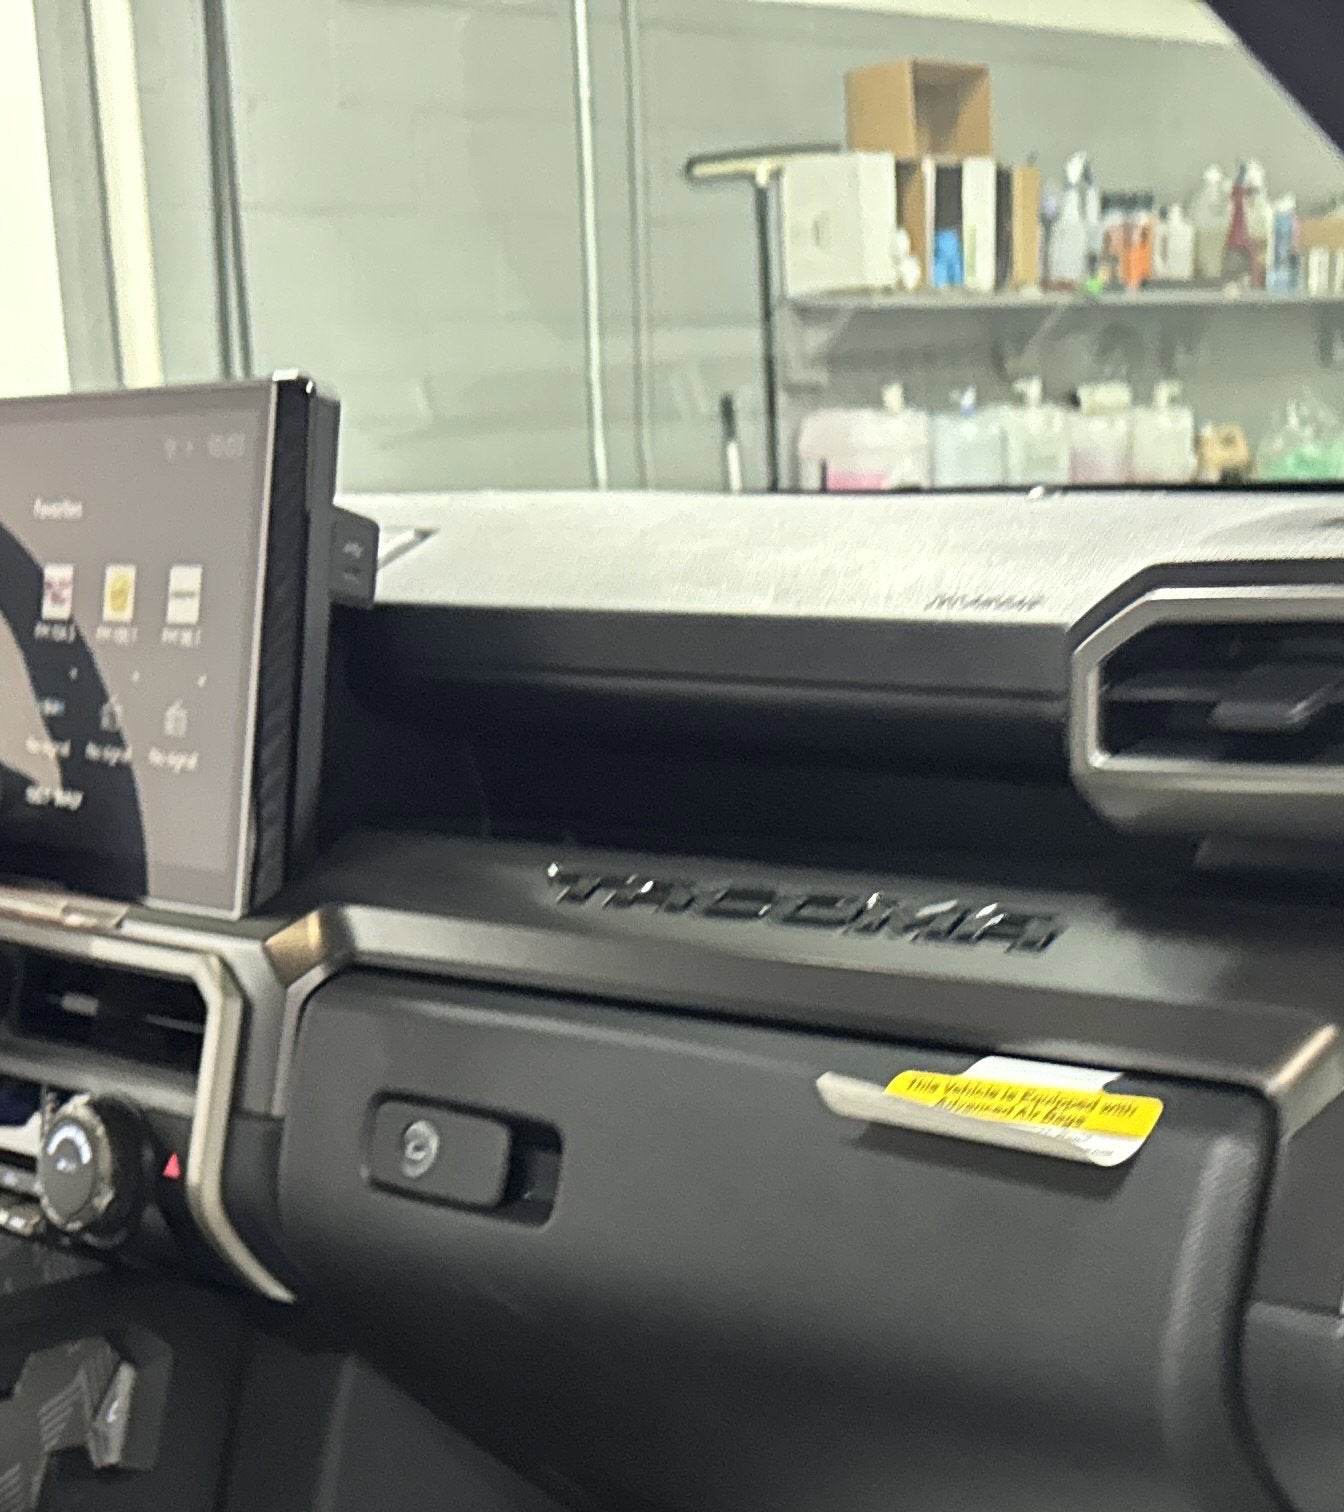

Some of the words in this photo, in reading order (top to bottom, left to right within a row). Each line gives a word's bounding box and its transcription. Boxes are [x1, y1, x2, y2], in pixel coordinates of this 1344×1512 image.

[547, 861, 1064, 955] TACOMA
[905, 1078, 941, 1095] This
[943, 1079, 1001, 1100] Vehicle
[1018, 1088, 1102, 1114] Equipped
[1099, 1101, 1138, 1118] with
[935, 1096, 1016, 1117] Advanced
[1012, 1105, 1042, 1122] Air
